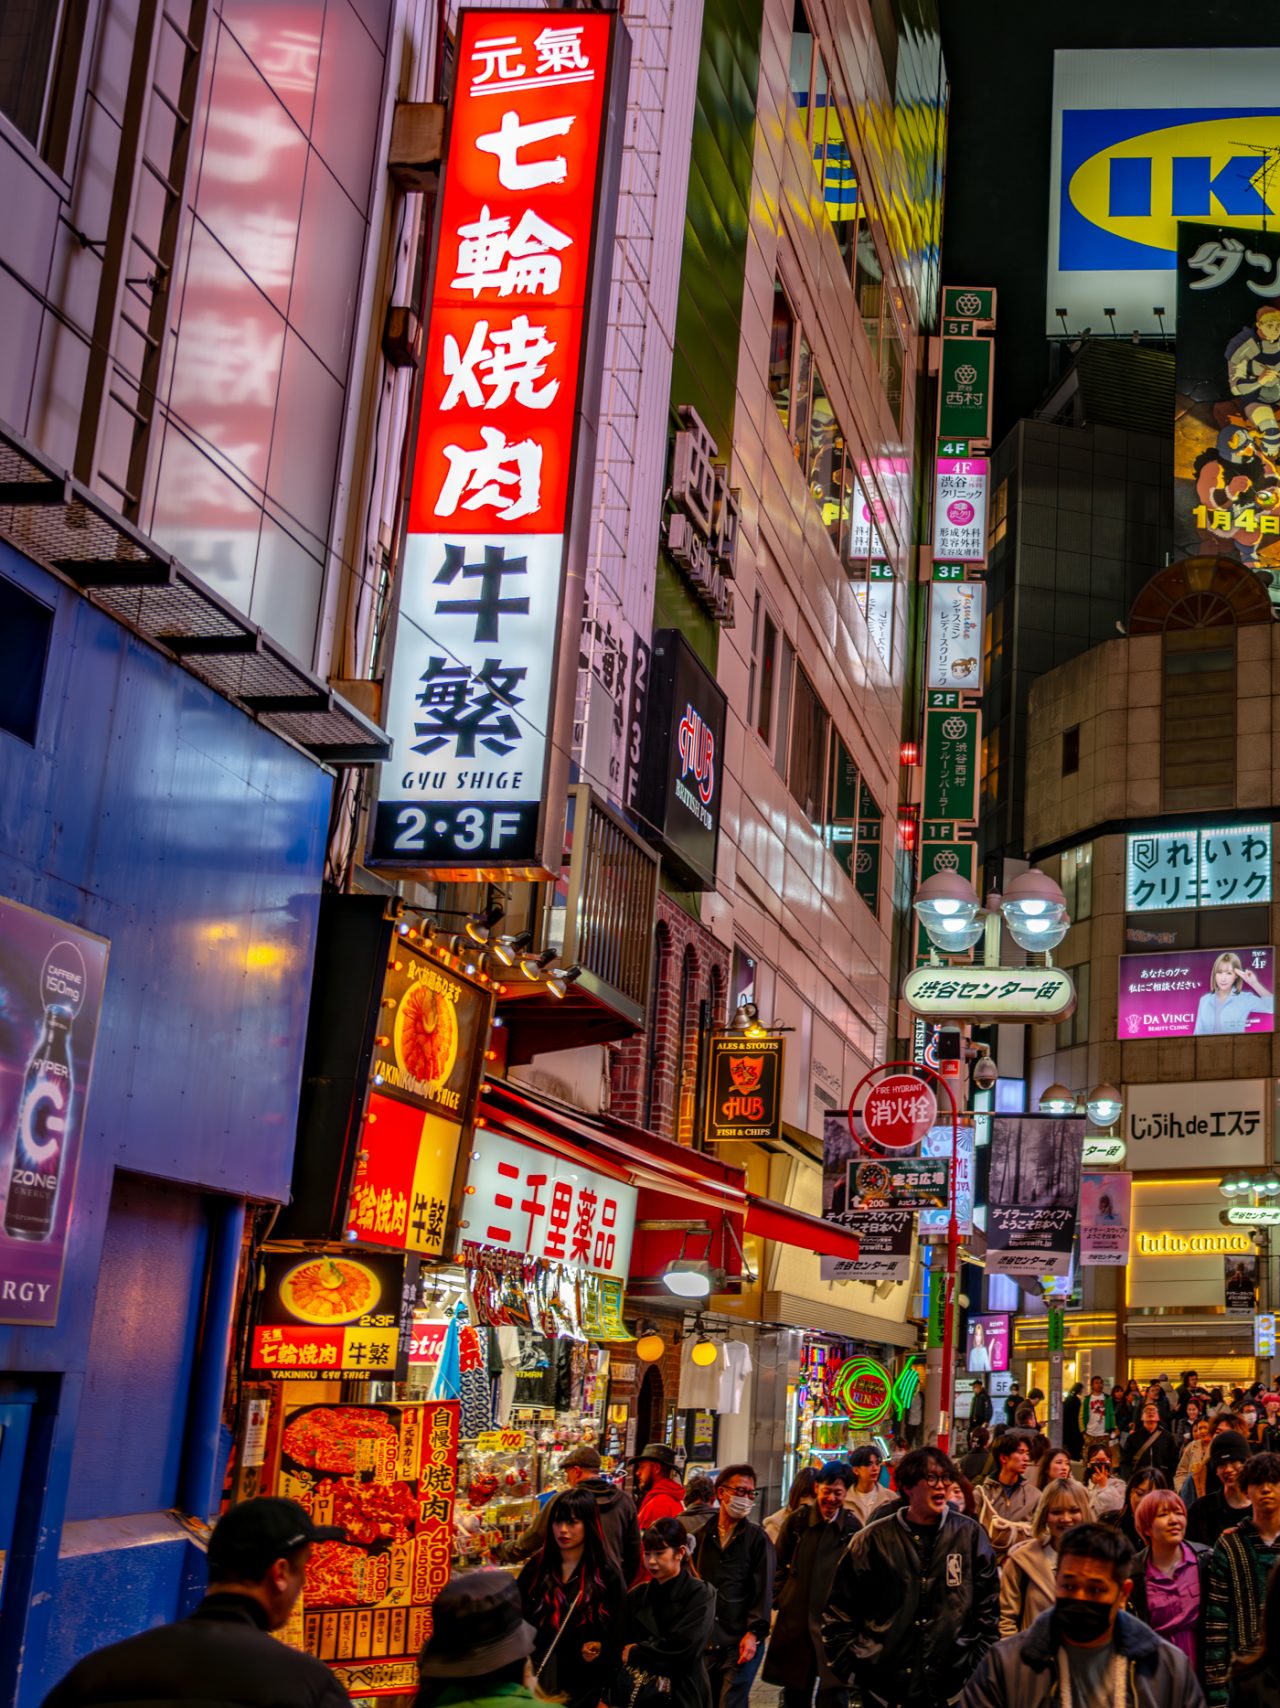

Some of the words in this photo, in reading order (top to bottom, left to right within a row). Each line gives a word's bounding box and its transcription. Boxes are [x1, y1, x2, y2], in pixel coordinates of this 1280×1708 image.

[471, 27, 589, 83] 元氣
[434, 111, 577, 520] 七輪焼肉
[949, 322, 970, 334] 5F
[945, 392, 984, 406] 西村
[943, 443, 965, 454] 4F
[952, 462, 972, 474] 4F
[941, 476, 967, 488] 渋谷
[941, 490, 982, 498] クリニック
[938, 566, 961, 577] 3F
[951, 599, 961, 639] ジャスミン
[411, 543, 531, 758] 牛繁
[938, 611, 948, 686] レディースクリニック
[934, 694, 956, 705] 2F
[678, 703, 714, 804] HUB
[400, 771, 446, 790] GYU
[457, 771, 523, 789] SHIGE
[930, 826, 951, 838] 1F
[1167, 835, 1268, 868] れいわ
[1133, 871, 1268, 906] クリニック
[1252, 957, 1266, 969] 4F
[48, 964, 82, 985] CAFFEINE
[45, 976, 79, 1002] 150mg
[913, 981, 1064, 1000] 渋谷センター街
[1143, 1014, 1160, 1024] DA
[1161, 1013, 1195, 1023] VINCI
[32, 1057, 69, 1079] HYPER
[876, 1086, 890, 1094] FIRE
[892, 1084, 923, 1093] HYDRANT
[436, 1088, 461, 1111] SHIGE
[721, 1096, 763, 1121] HUB
[870, 1099, 930, 1128] 消火栓
[892, 1173, 945, 1186] 宝石広場
[868, 1200, 889, 1208] 200m
[412, 1192, 445, 1247] 牛繁
[487, 1162, 617, 1270] 三千里薬品
[825, 1212, 910, 1222] テイラー・スウィフト
[992, 1209, 1072, 1219] テイラー・スウィフト
[998, 1220, 1064, 1230] ようこそ日本へ!
[1139, 1232, 1188, 1253] tutu
[1190, 1234, 1248, 1252] anna
[260, 1343, 337, 1365] 七輪焼肉
[349, 1342, 390, 1365] 牛繁
[271, 1370, 317, 1379] YAKINIKU
[321, 1371, 340, 1379] GYU
[343, 1371, 370, 1379] SHIGE
[515, 1370, 544, 1378] ATMAN
[995, 1379, 1008, 1392] 5F
[420, 1408, 453, 1524] 自慢の焼肉
[394, 1549, 408, 1582] ハラミ
